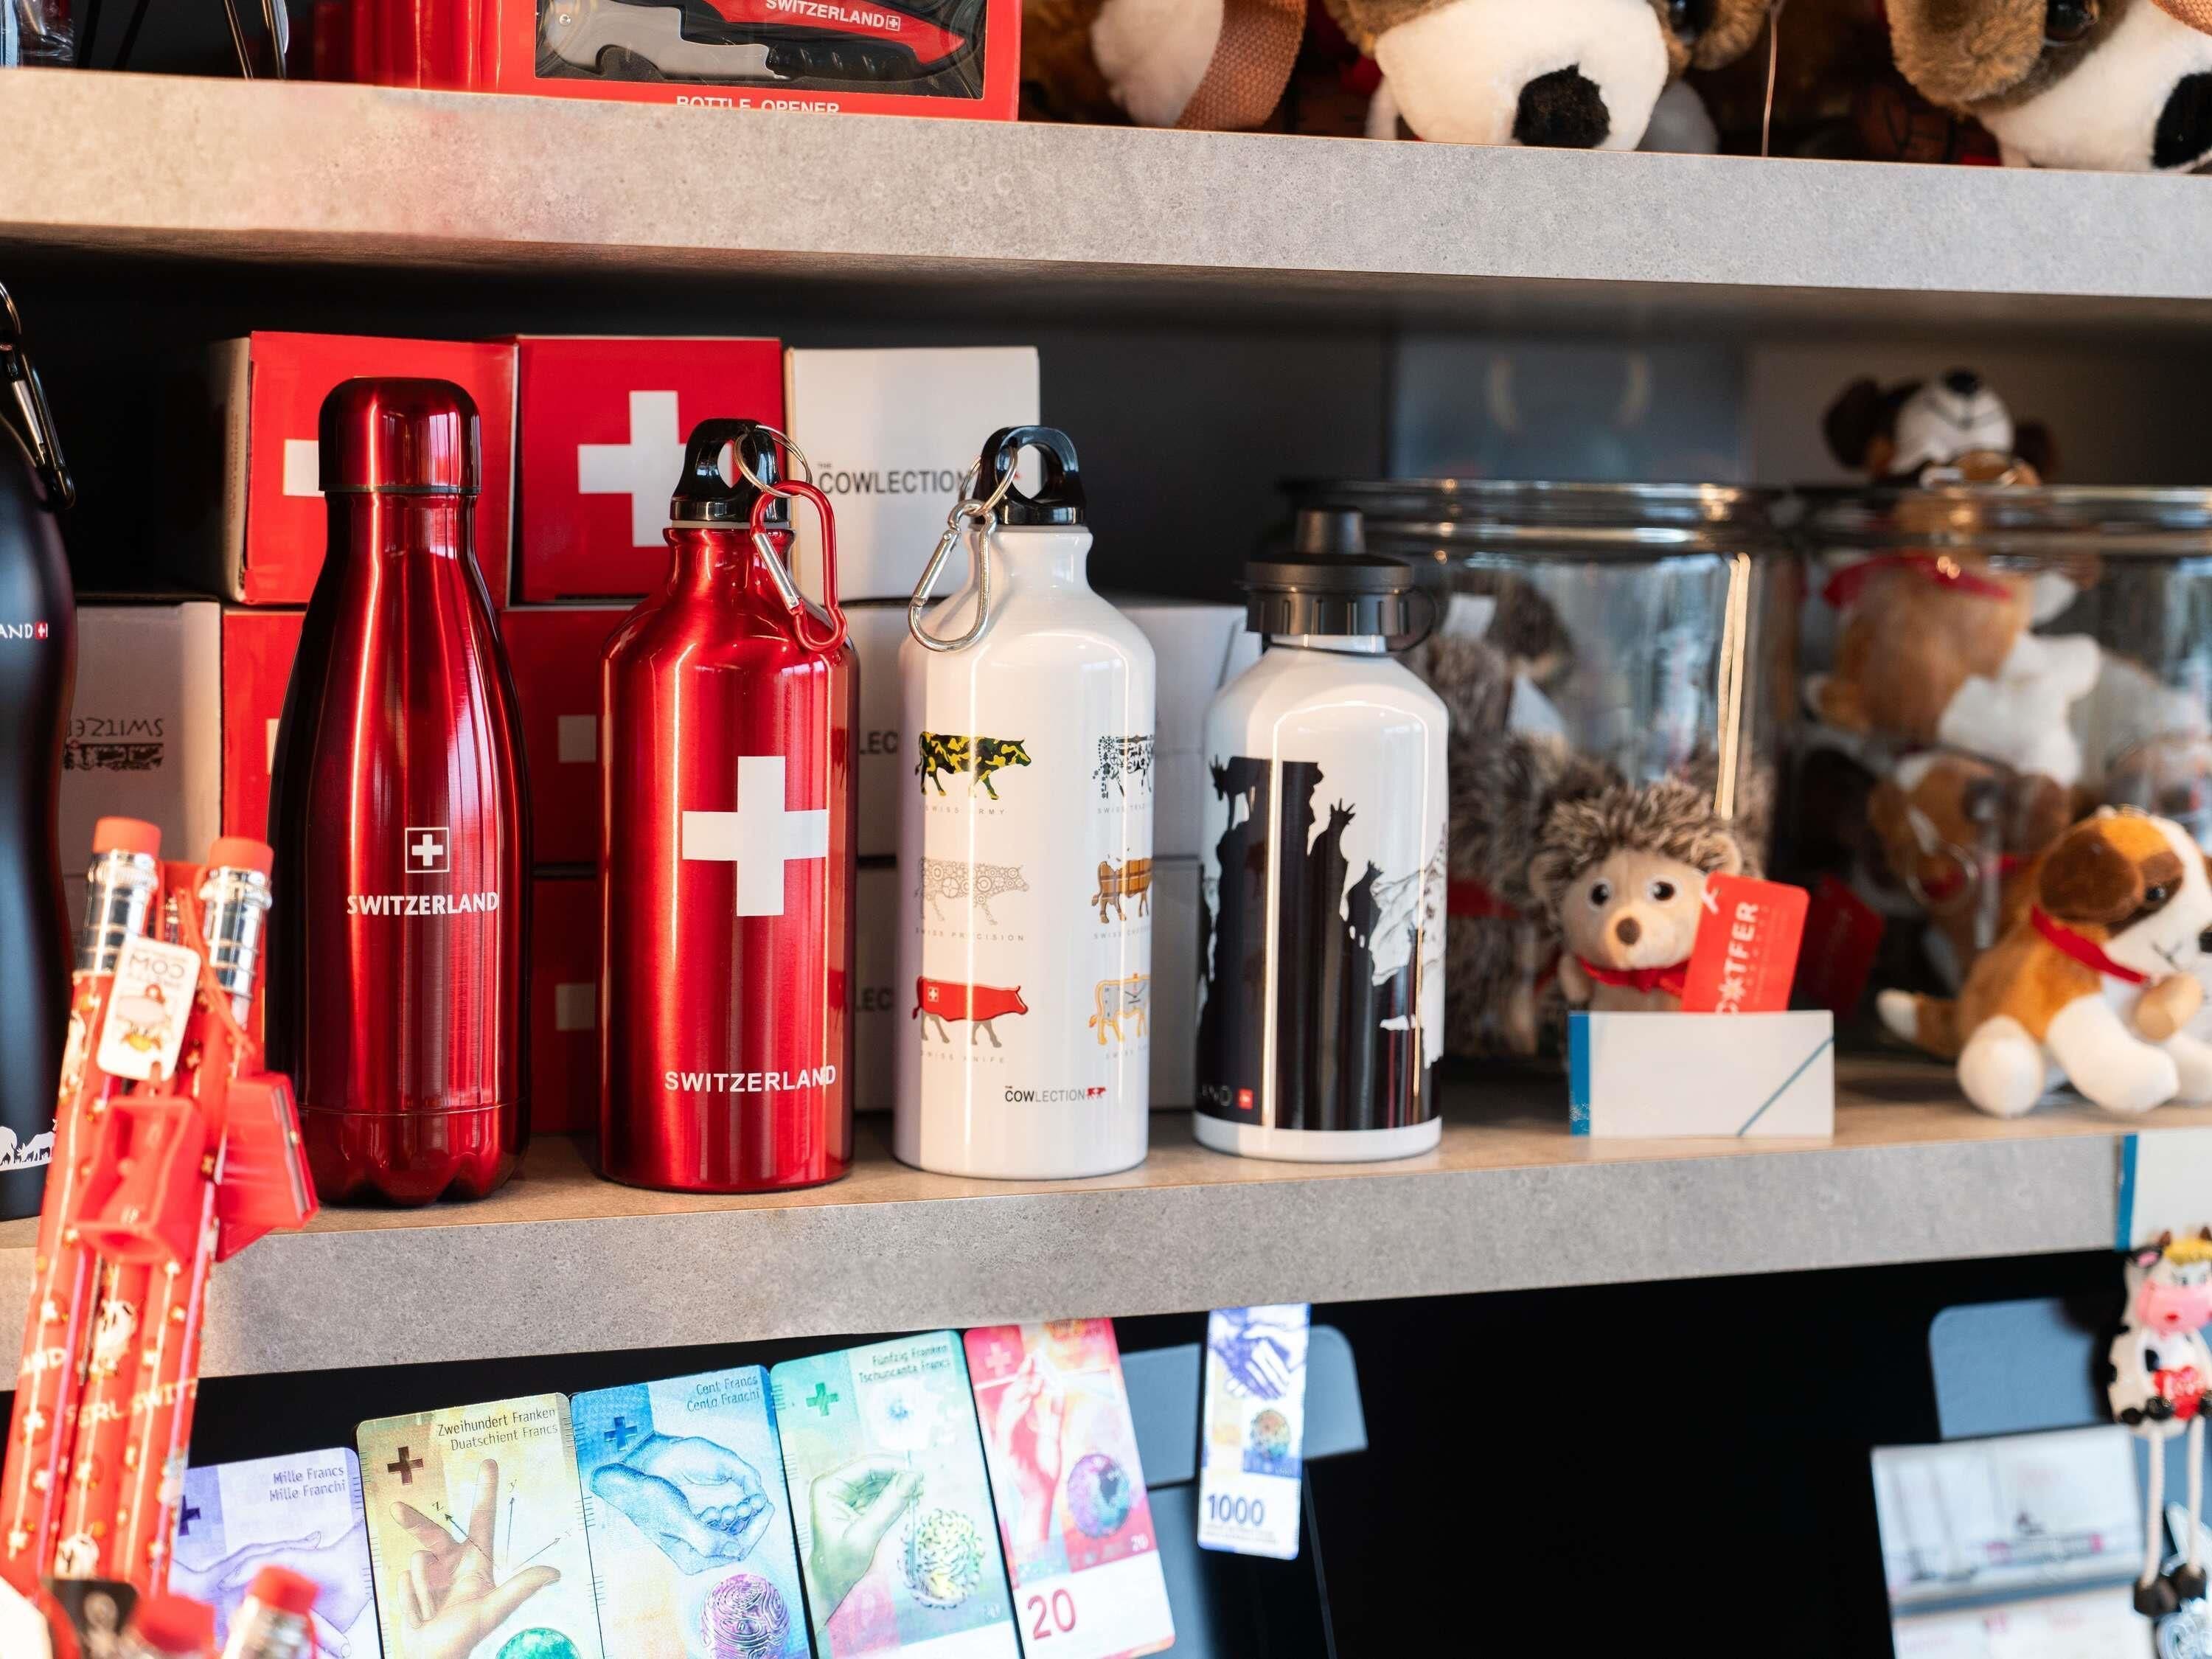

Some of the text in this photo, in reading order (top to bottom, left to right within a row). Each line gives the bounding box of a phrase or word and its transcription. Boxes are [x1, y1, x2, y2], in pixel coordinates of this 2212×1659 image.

[766, 0, 885, 28] SWITZERLAND
[347, 891, 499, 916] SWITZERLAND
[951, 932, 1024, 942] PRCISION
[664, 1065, 837, 1093] SWITZERLAND
[1005, 1089, 1085, 1103] COWLECTION
[696, 1376, 758, 1396] Cent Francs
[687, 1388, 759, 1412] Cento Franchi
[437, 1408, 555, 1436] Zweihundert Franken
[451, 1425, 558, 1451] Duatschient Francs
[274, 1467, 344, 1484] Mille Francs
[269, 1479, 346, 1502] Mille Franchi
[1207, 1493, 1265, 1526] 1000
[1027, 1588, 1077, 1641] 20
